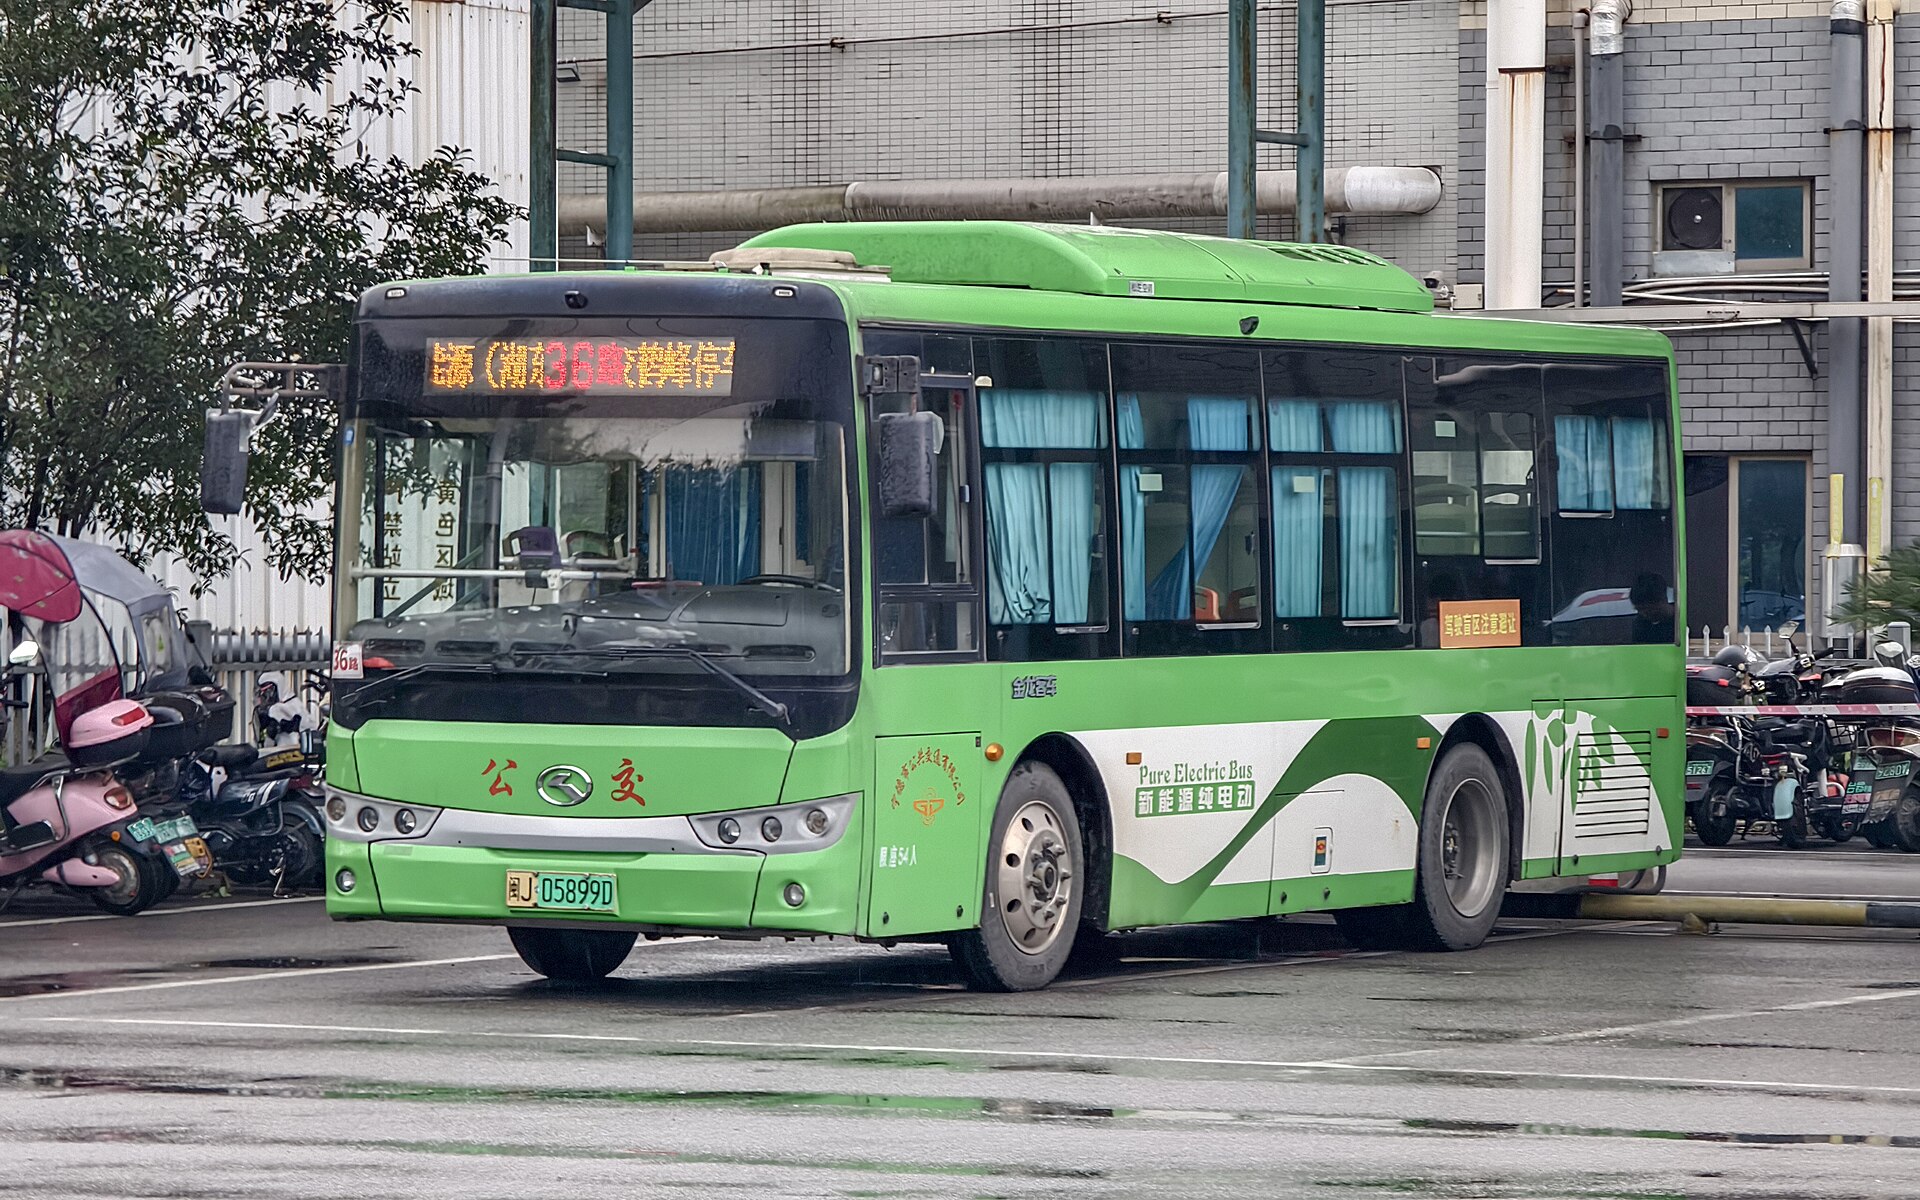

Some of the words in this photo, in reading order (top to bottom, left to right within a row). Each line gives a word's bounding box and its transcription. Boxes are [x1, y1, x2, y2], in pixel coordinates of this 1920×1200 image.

[1444, 612, 1517, 637] 驾驶盲区注意避让
[1139, 765, 1171, 785] Pure
[1173, 761, 1225, 783] Electric
[1229, 760, 1253, 780] Bus
[1138, 784, 1253, 815] 新能源纯电动
